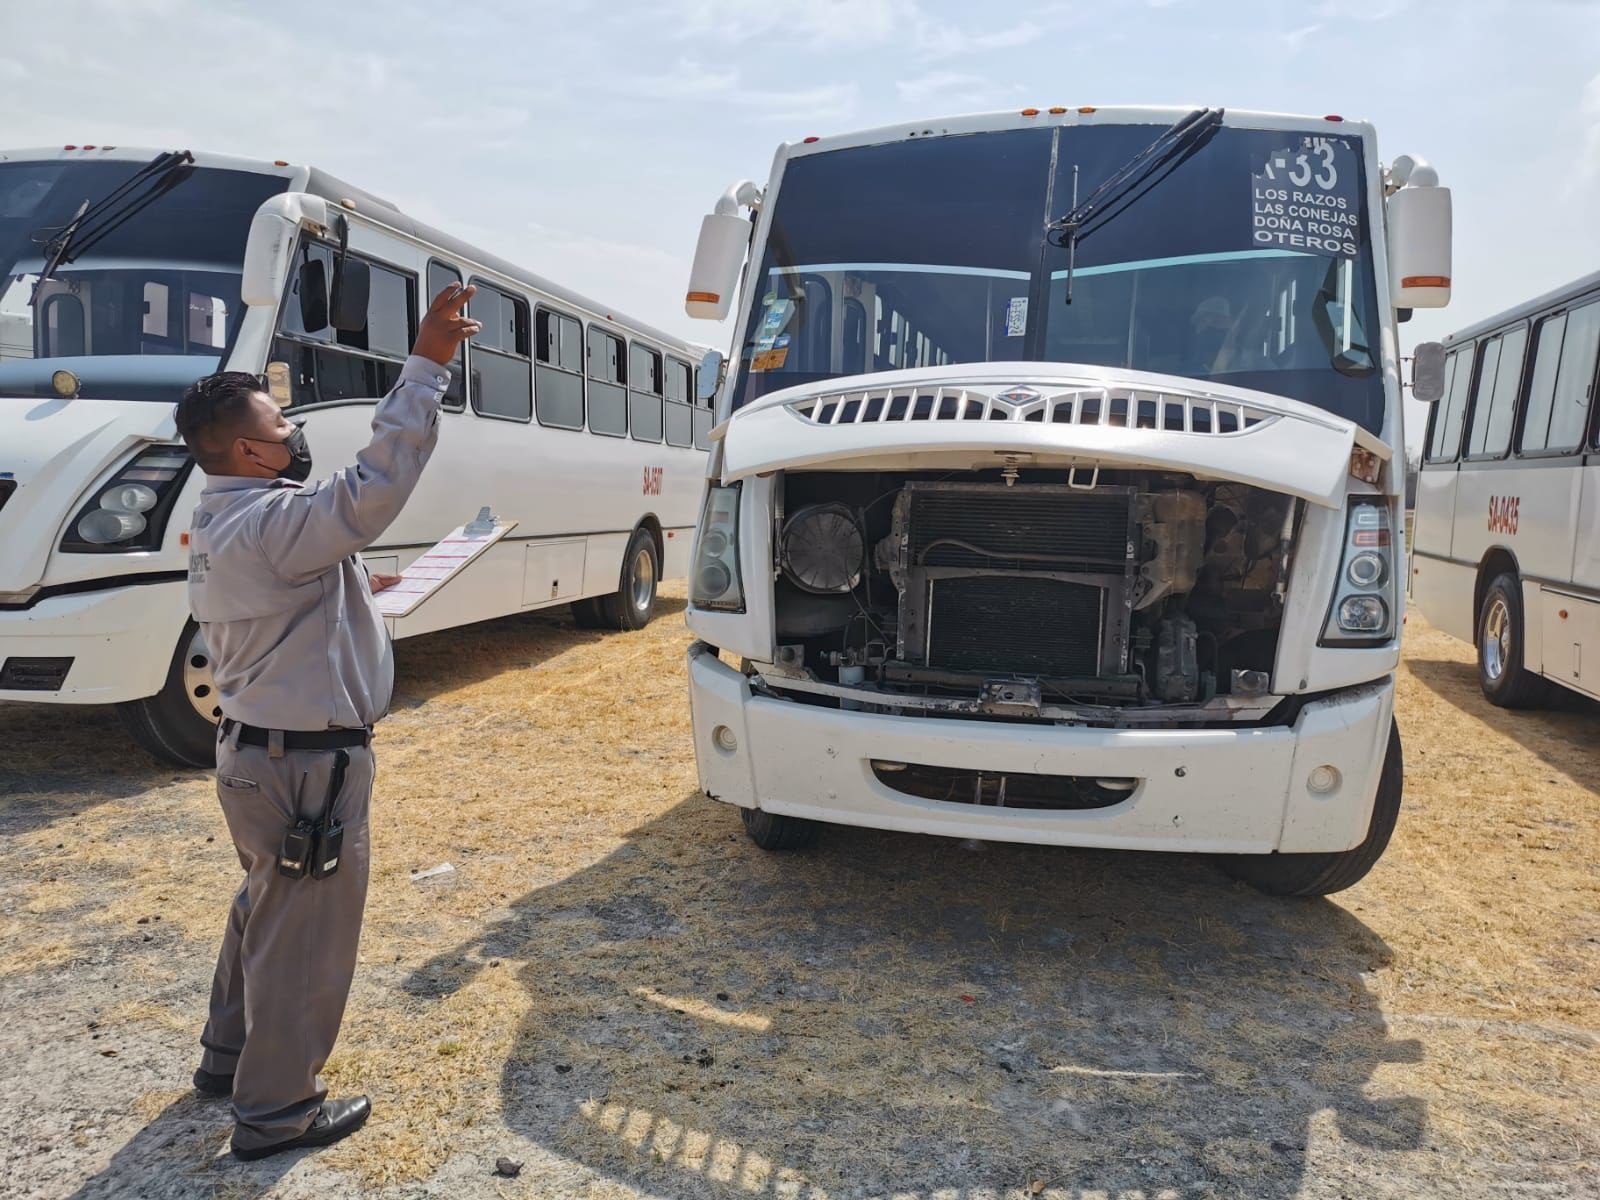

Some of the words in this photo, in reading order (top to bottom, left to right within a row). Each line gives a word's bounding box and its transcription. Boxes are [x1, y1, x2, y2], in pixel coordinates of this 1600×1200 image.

[1255, 188, 1288, 201] LOS
[1293, 191, 1347, 209] RAZOS
[1254, 202, 1284, 215] LAS
[1288, 205, 1358, 226] CONEJAS
[1254, 215, 1303, 231] DOÑA
[1308, 222, 1354, 240] ROSA
[1254, 230, 1357, 255] OTEROS
[1487, 495, 1520, 535] SA-0435
